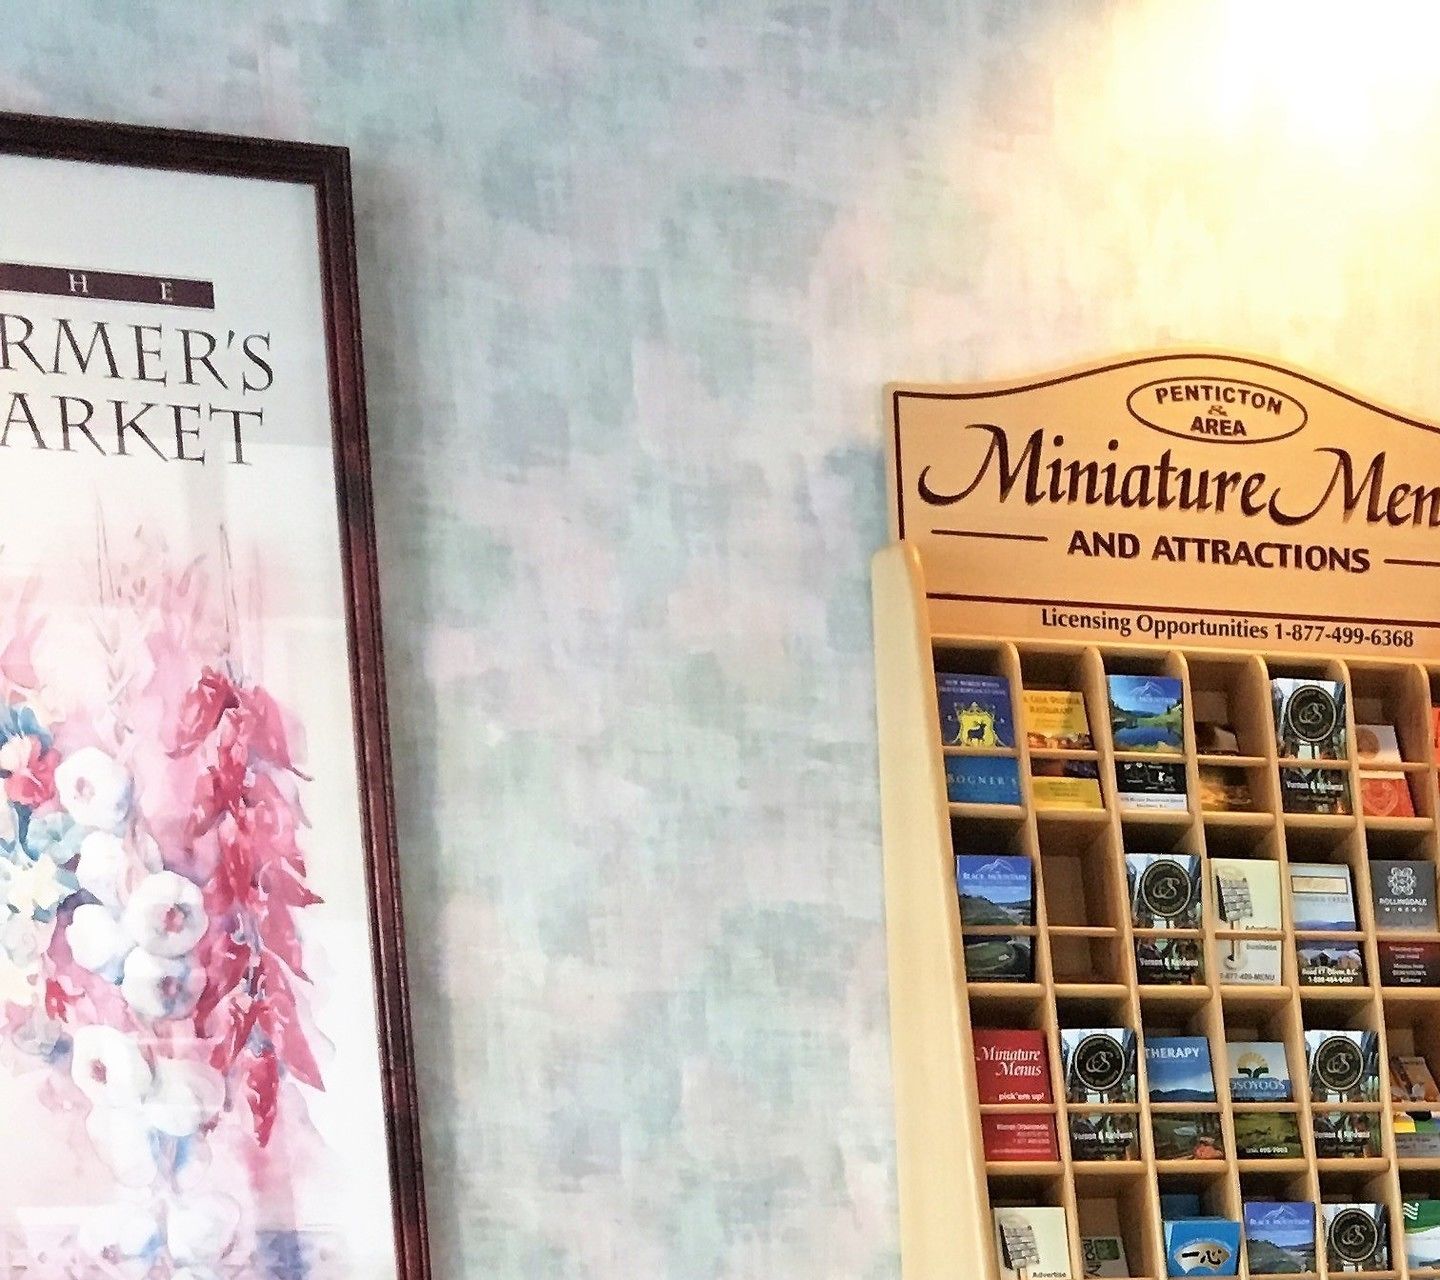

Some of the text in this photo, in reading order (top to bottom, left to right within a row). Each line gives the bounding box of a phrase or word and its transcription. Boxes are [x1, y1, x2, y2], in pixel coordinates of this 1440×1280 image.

[1155, 383, 1283, 415] PENTICTON
[0, 391, 264, 466] ARKET
[1190, 415, 1247, 438] AREA
[918, 423, 1268, 514] Miniature
[1067, 530, 1371, 573] AND ATTRACTIONS
[1041, 608, 1415, 648] Licensing Opportunities 1-877-499-6368
[976, 1047, 1041, 1063] Miniature
[995, 1061, 1042, 1077] Menus
[1145, 1046, 1200, 1060] THERAPY
